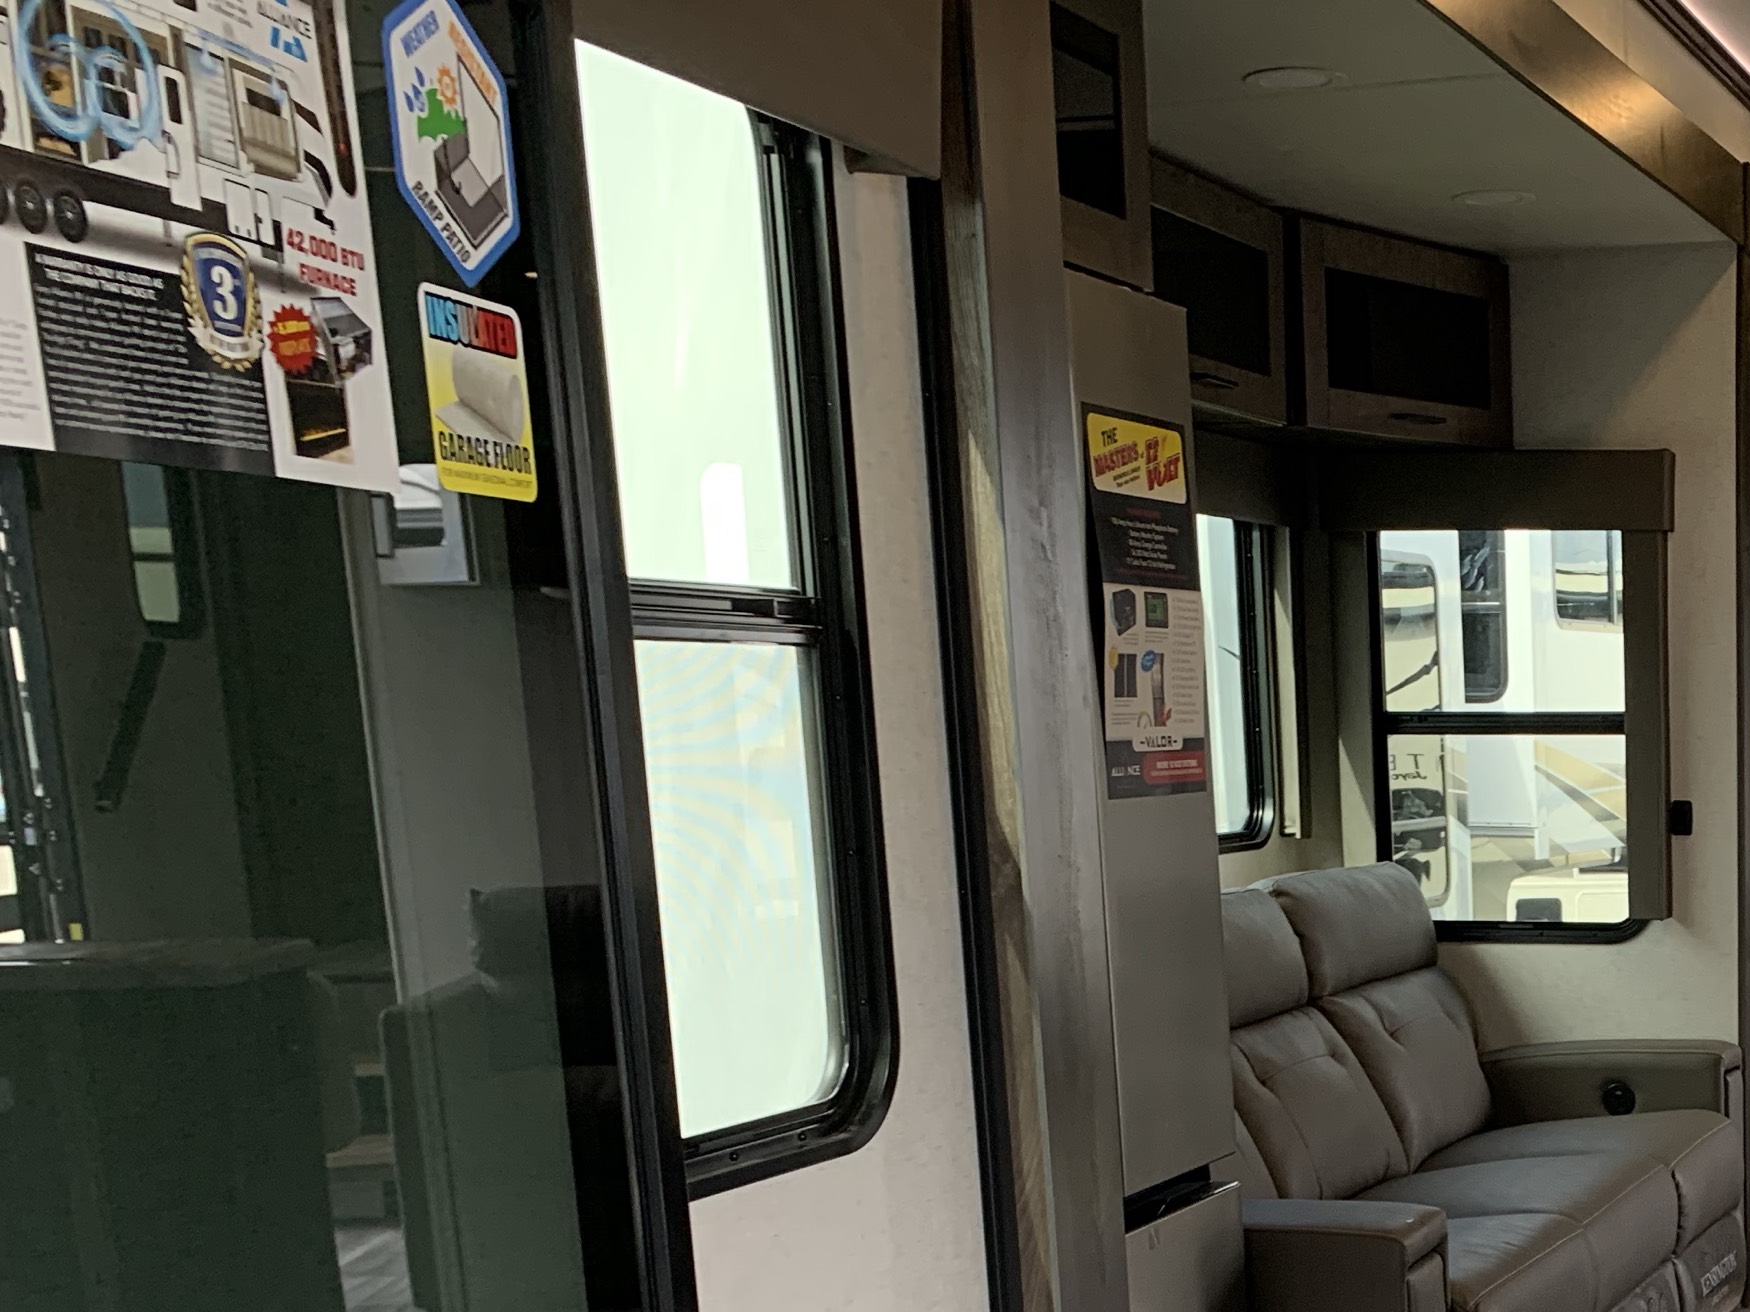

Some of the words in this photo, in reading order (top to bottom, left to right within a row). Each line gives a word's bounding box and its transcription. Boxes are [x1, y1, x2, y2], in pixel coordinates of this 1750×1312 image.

[411, 181, 443, 222] RAMP
[440, 222, 471, 263] PATIO
[287, 228, 337, 262] 42,000
[340, 248, 365, 271] BTU
[210, 265, 238, 320] 3
[299, 263, 357, 296] FURNACE
[426, 292, 519, 359] INSULATED
[438, 431, 491, 468] GARAGE
[492, 441, 533, 475] FLOOR
[1101, 427, 1118, 447] THE
[1093, 441, 1139, 477] MASTERS
